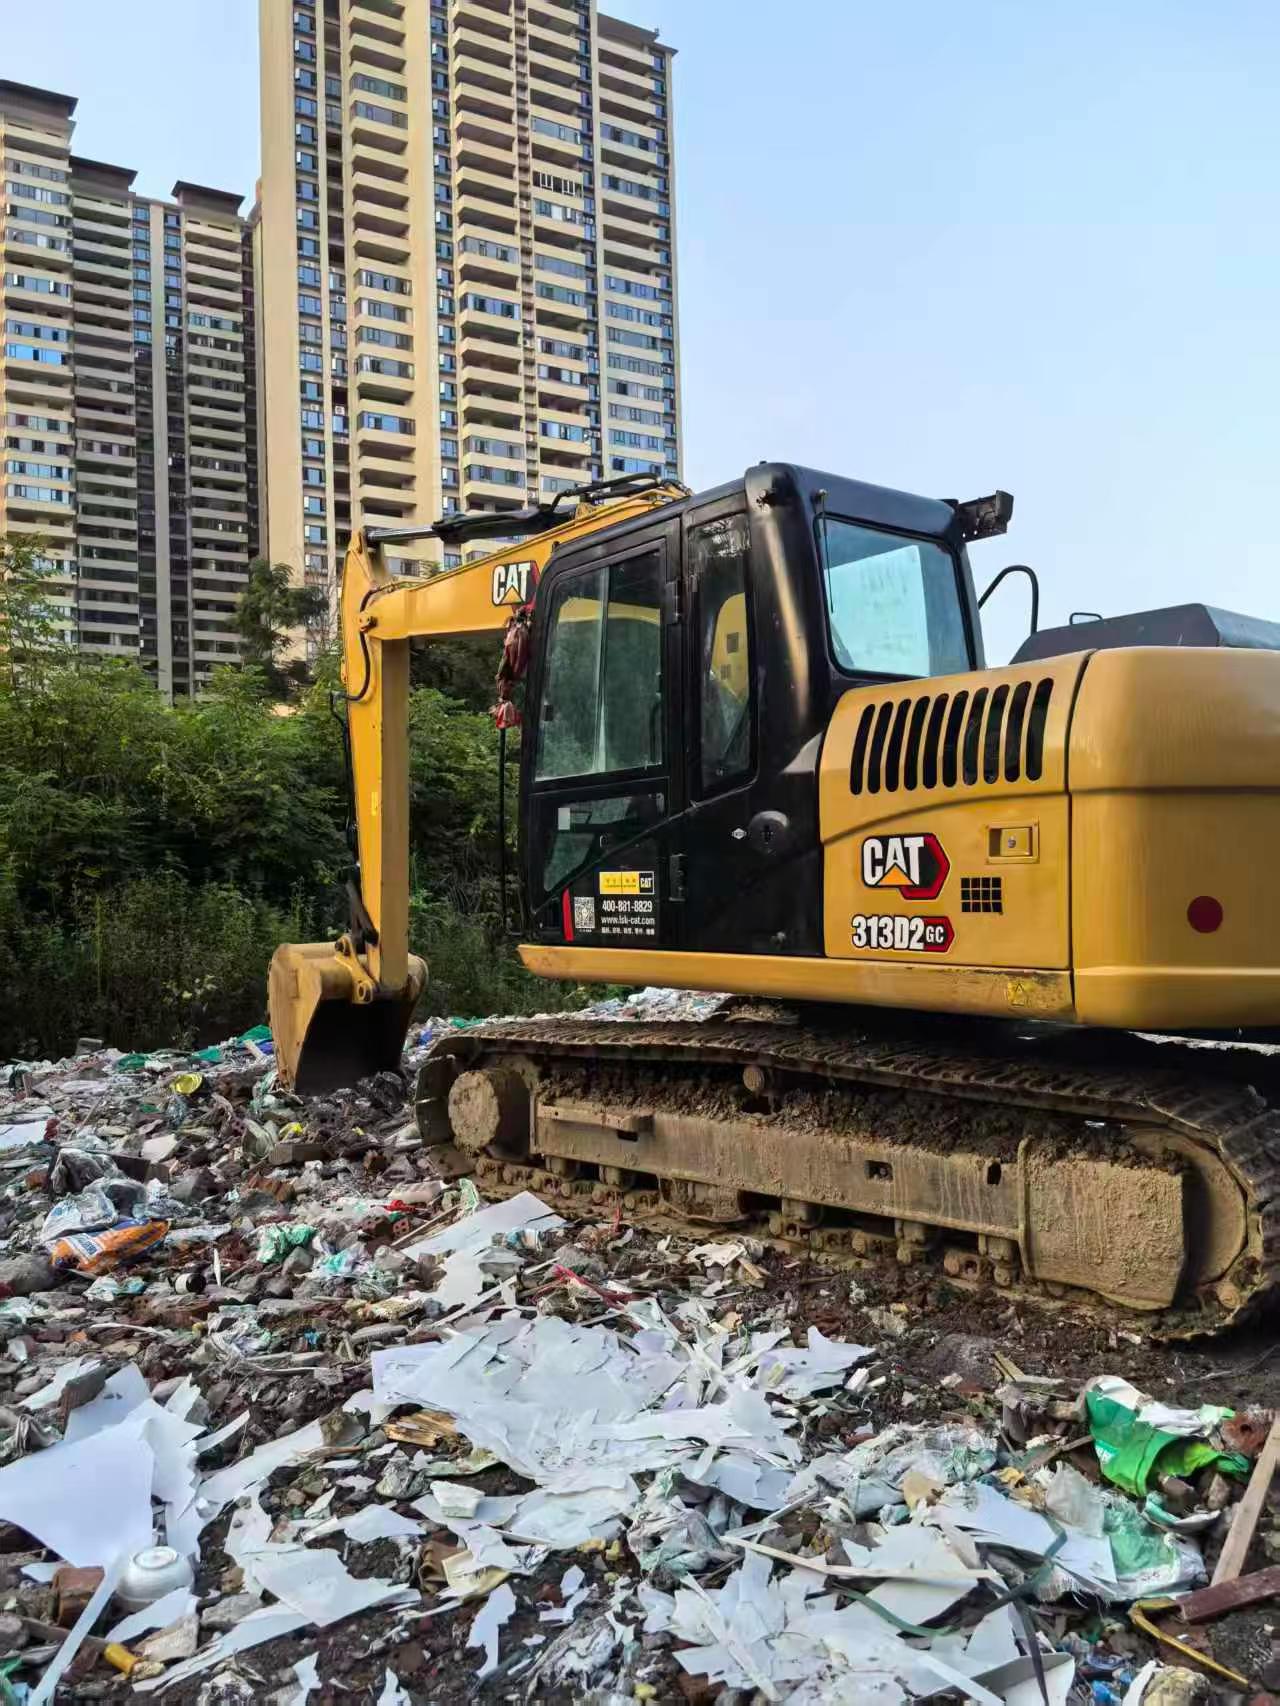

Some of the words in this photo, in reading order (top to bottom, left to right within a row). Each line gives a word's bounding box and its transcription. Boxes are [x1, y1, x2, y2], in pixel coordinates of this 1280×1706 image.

[493, 562, 531, 605] CAT
[863, 836, 925, 886] CAT
[640, 877, 653, 888] CAT
[852, 915, 925, 950] 313D2
[925, 925, 944, 943] GC
